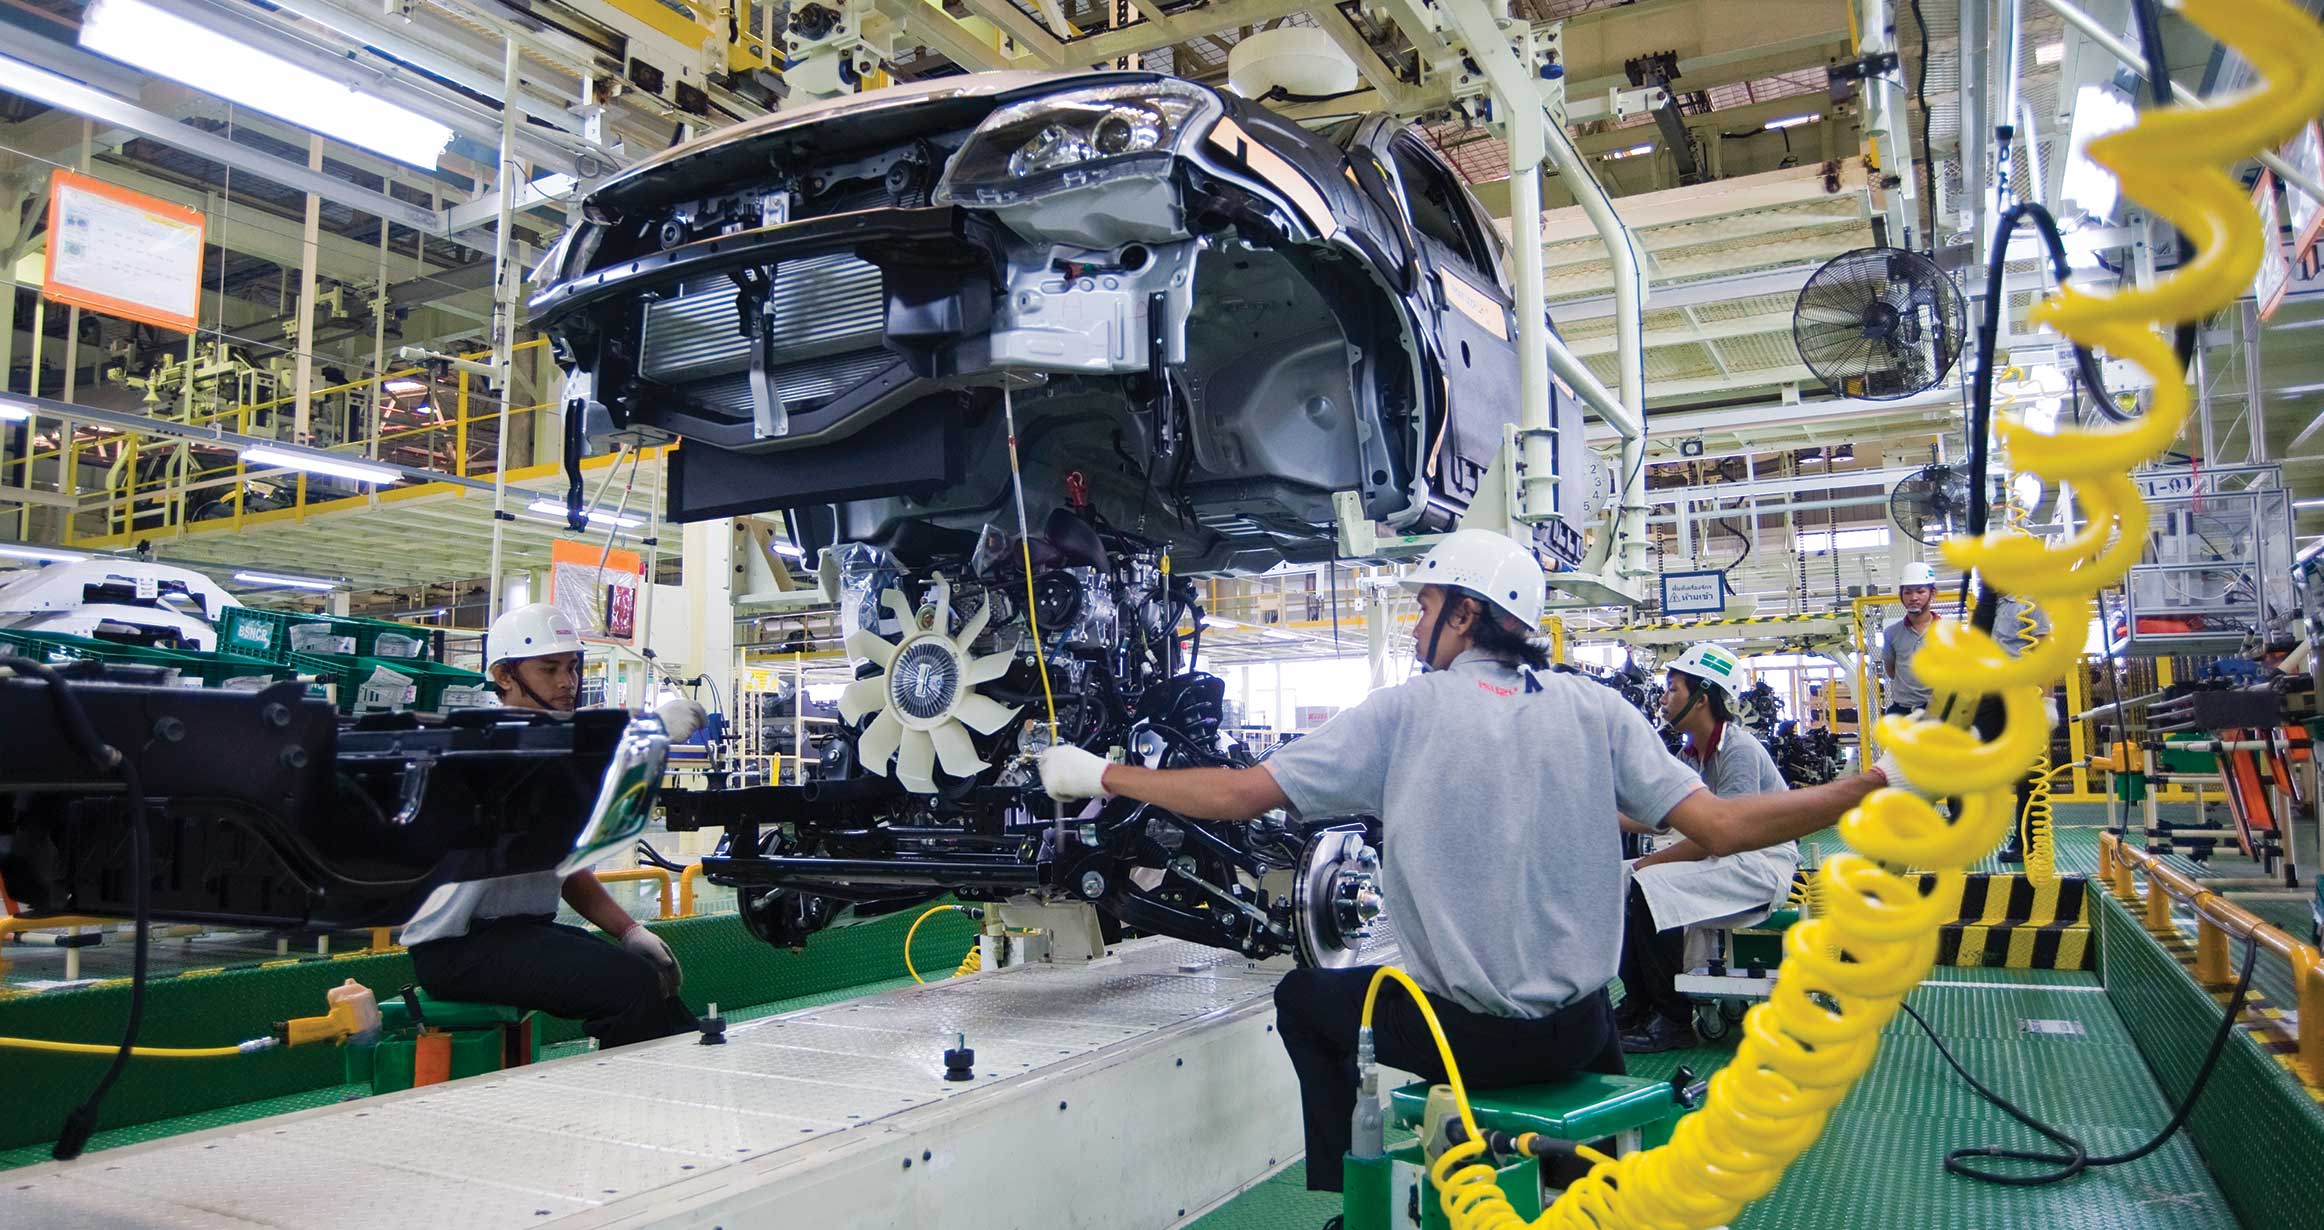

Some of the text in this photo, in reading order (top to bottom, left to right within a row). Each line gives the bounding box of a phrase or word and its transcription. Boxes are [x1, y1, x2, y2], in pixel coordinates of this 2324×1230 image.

[1590, 464, 1597, 474] 2
[1594, 477, 1602, 487] 3
[1592, 490, 1600, 499] 4
[1583, 501, 1590, 511] 5
[1682, 592, 1713, 601] ห้ามเข้า
